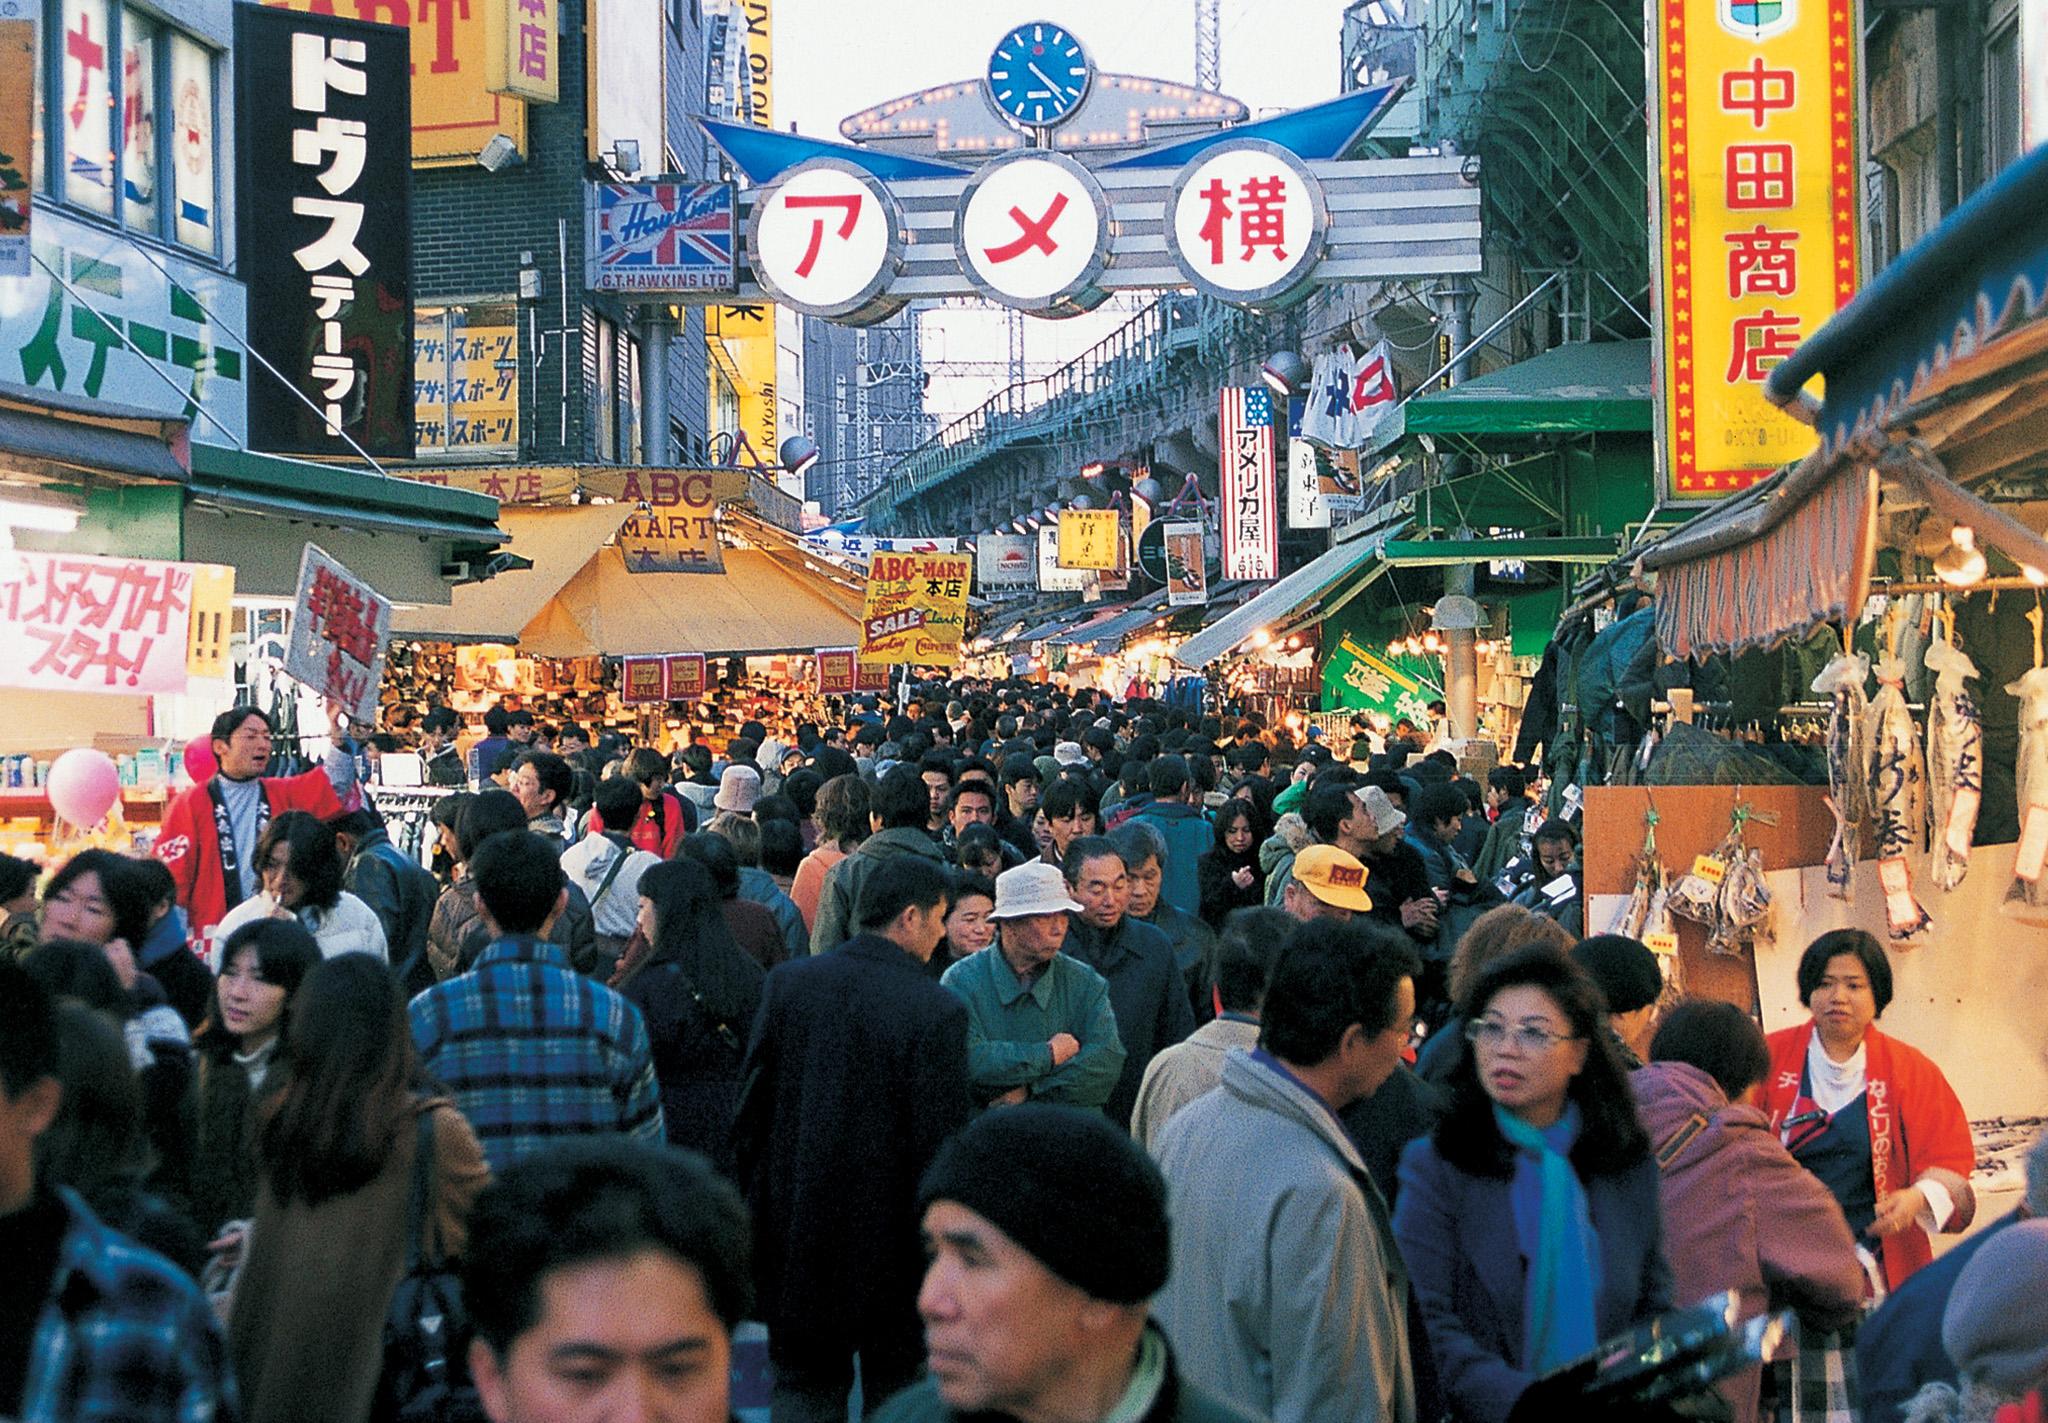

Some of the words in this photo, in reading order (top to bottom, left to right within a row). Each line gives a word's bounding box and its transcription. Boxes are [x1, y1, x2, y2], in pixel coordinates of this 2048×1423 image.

[620, 194, 723, 242] Hawkins
[784, 175, 1288, 278] アメ横
[1722, 57, 1803, 384] 中田商店
[621, 472, 712, 507] ABC
[1236, 430, 1261, 541] アメリカ屋
[621, 516, 712, 540] MART
[870, 556, 967, 582] ABC-MART
[0, 556, 190, 635] イントアップカード
[925, 578, 962, 598] 本店
[869, 607, 922, 638] SALE
[630, 684, 661, 697] SALE
[670, 680, 702, 694] SALE
[823, 675, 852, 688] SALE
[859, 673, 889, 687] SALE
